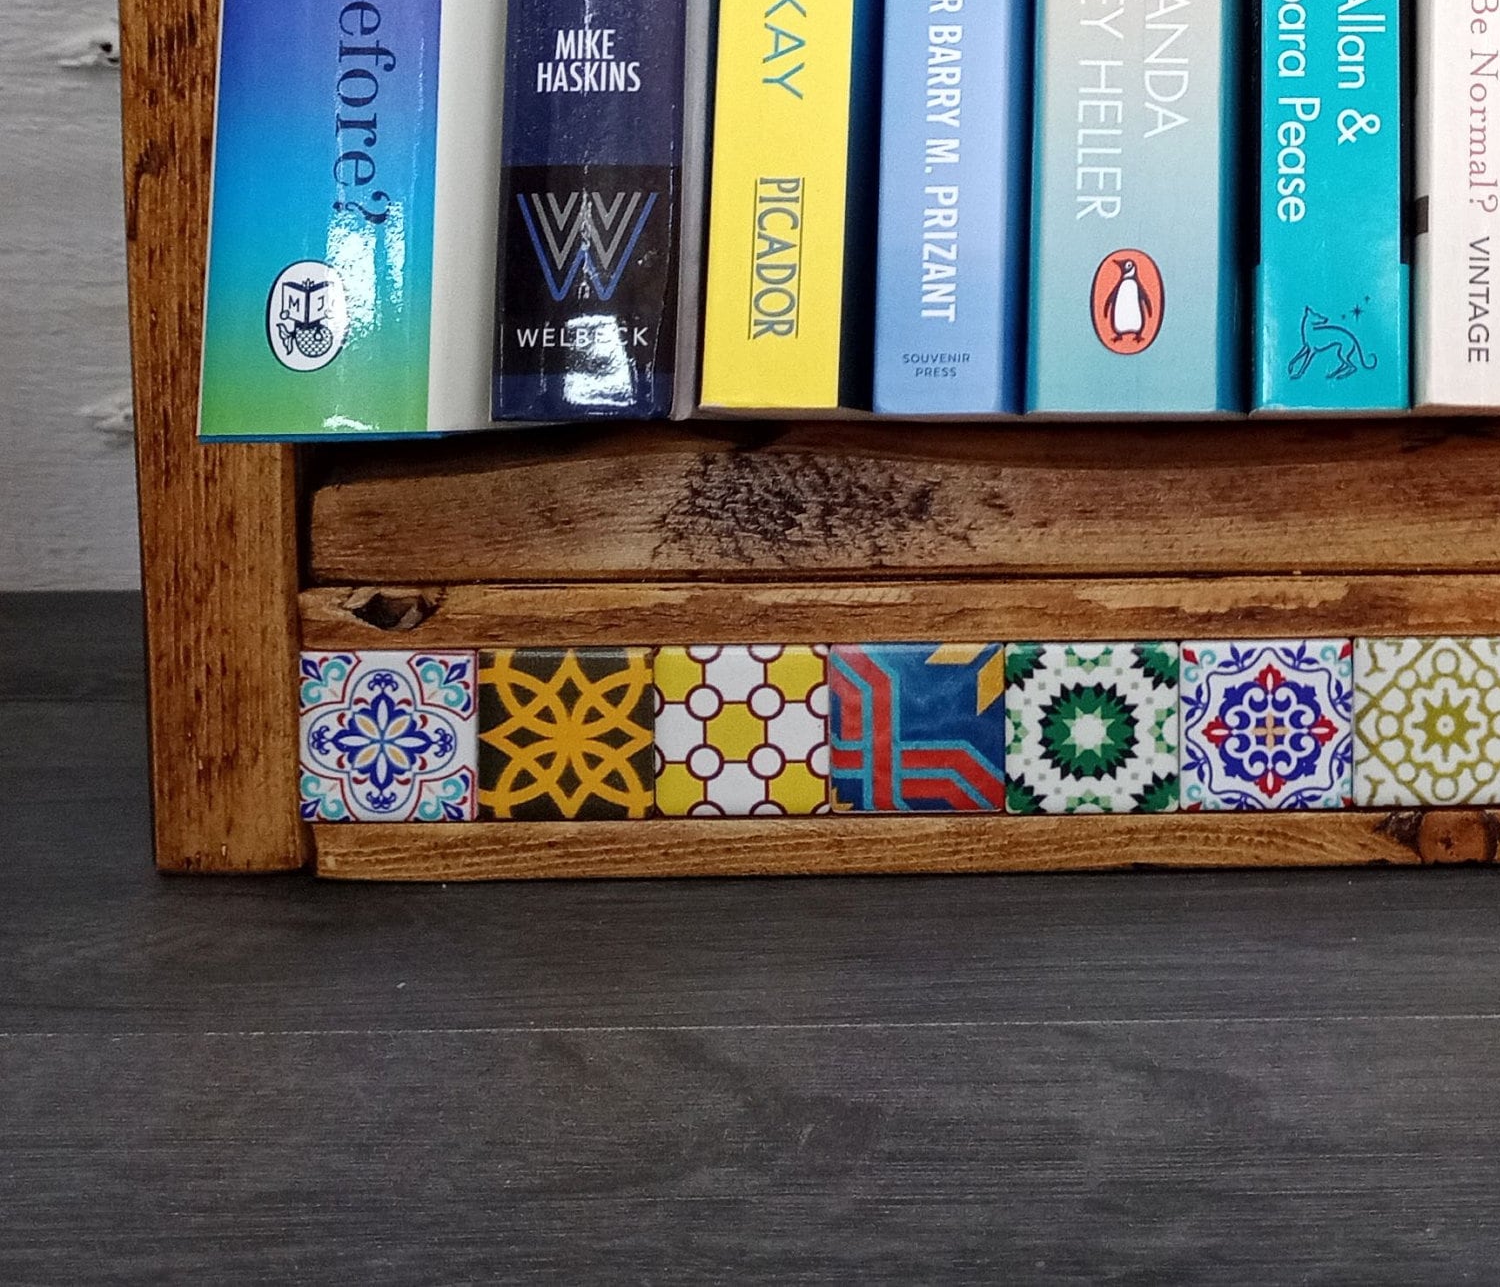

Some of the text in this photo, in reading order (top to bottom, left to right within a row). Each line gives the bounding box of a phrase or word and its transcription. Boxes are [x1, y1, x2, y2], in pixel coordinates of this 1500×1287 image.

[536, 61, 641, 93] HASKINS
[555, 30, 616, 60] MIKE
[925, 23, 963, 129] BARRY
[924, 138, 960, 174] M.
[1075, 59, 1124, 220] HELLER
[1277, 97, 1321, 224] Pease
[1336, 110, 1381, 145] &
[1469, 49, 1499, 214] Normal?
[753, 176, 801, 340] PICADOR
[920, 185, 959, 323] PRIZANT
[1468, 235, 1490, 364] VINTAGE
[516, 326, 649, 348] WELBECK
[902, 352, 971, 364] SOUVENIR
[915, 367, 957, 378] PRESS
